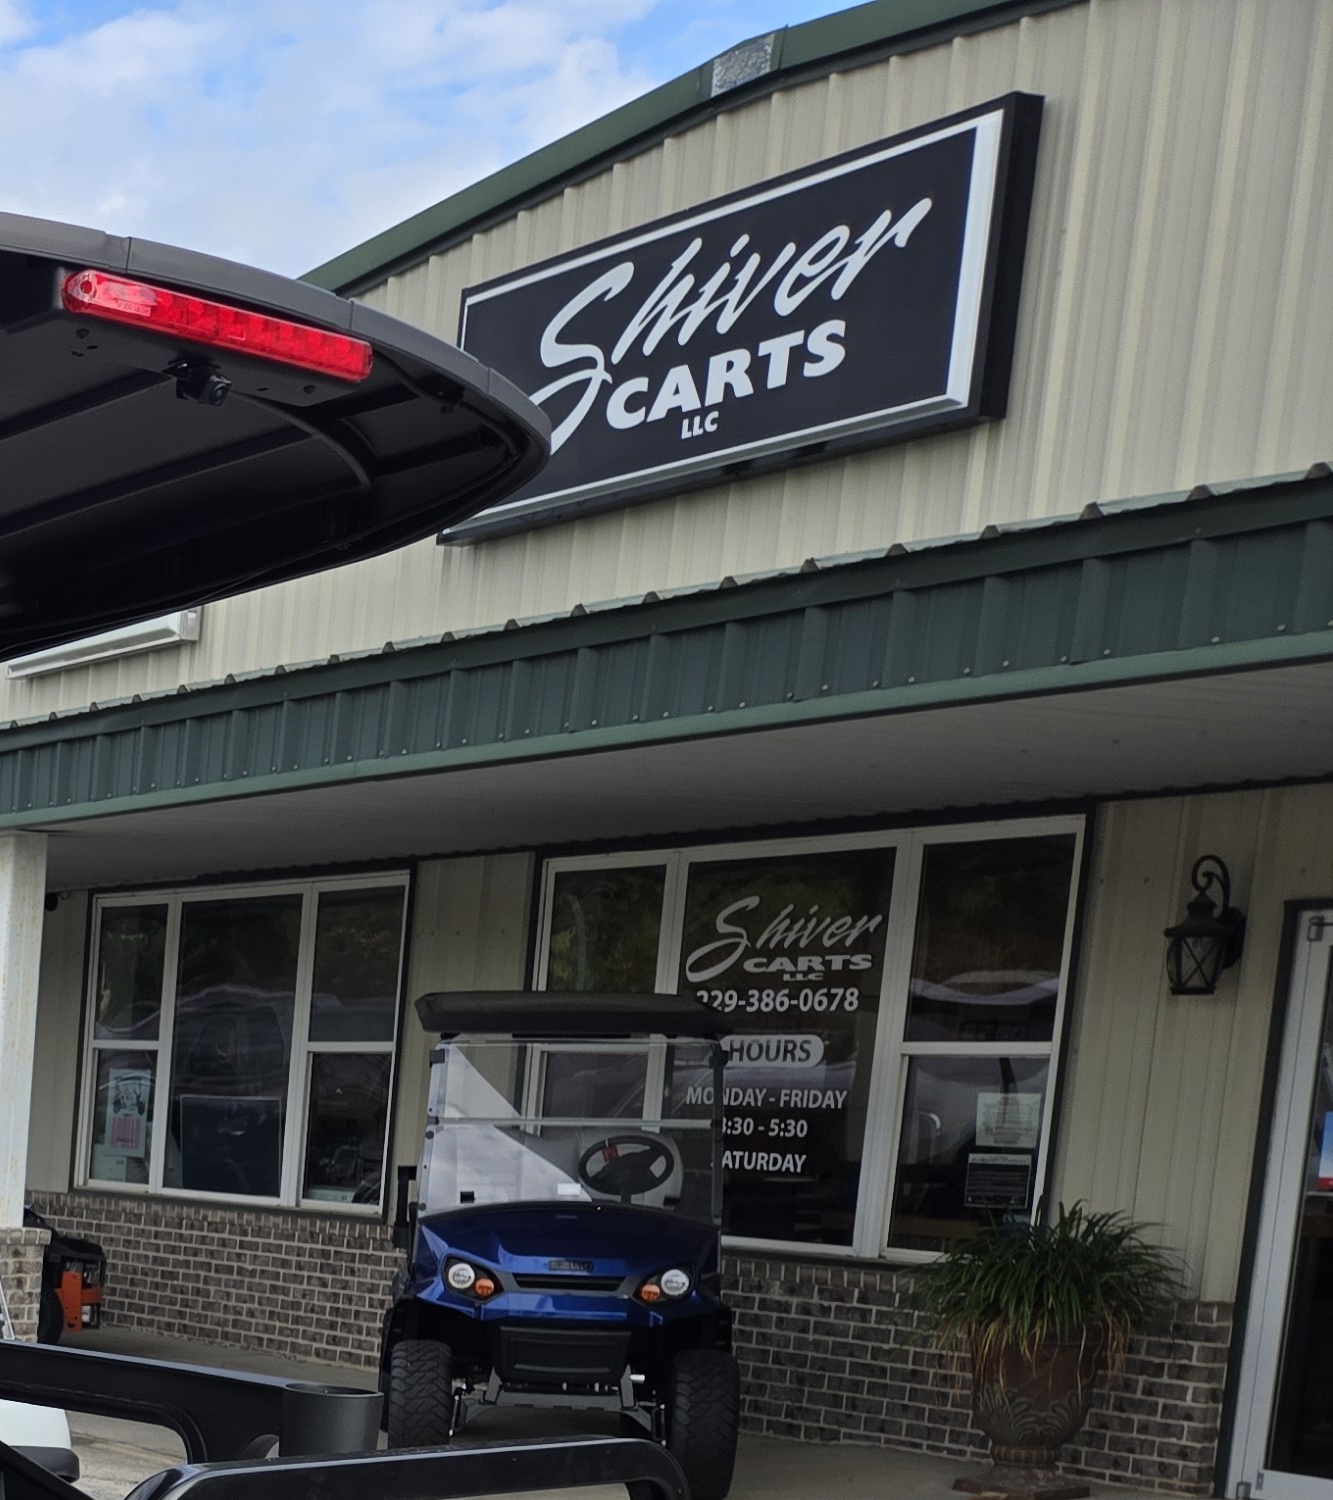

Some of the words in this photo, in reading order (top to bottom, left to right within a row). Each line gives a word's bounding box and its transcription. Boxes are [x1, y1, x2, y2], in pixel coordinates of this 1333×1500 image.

[530, 198, 932, 455] Shiver
[606, 319, 846, 429] CARTS
[681, 411, 718, 439] LLC
[686, 896, 883, 983] Shiver
[742, 953, 872, 974] CARTS
[783, 973, 824, 981] LLC
[696, 987, 859, 1013] 229-386-0678
[728, 1039, 812, 1062] HOURS
[779, 1089, 848, 1109] FRIDAY
[768, 1118, 808, 1139] 5:30
[711, 1150, 807, 1173] ATURDAY
